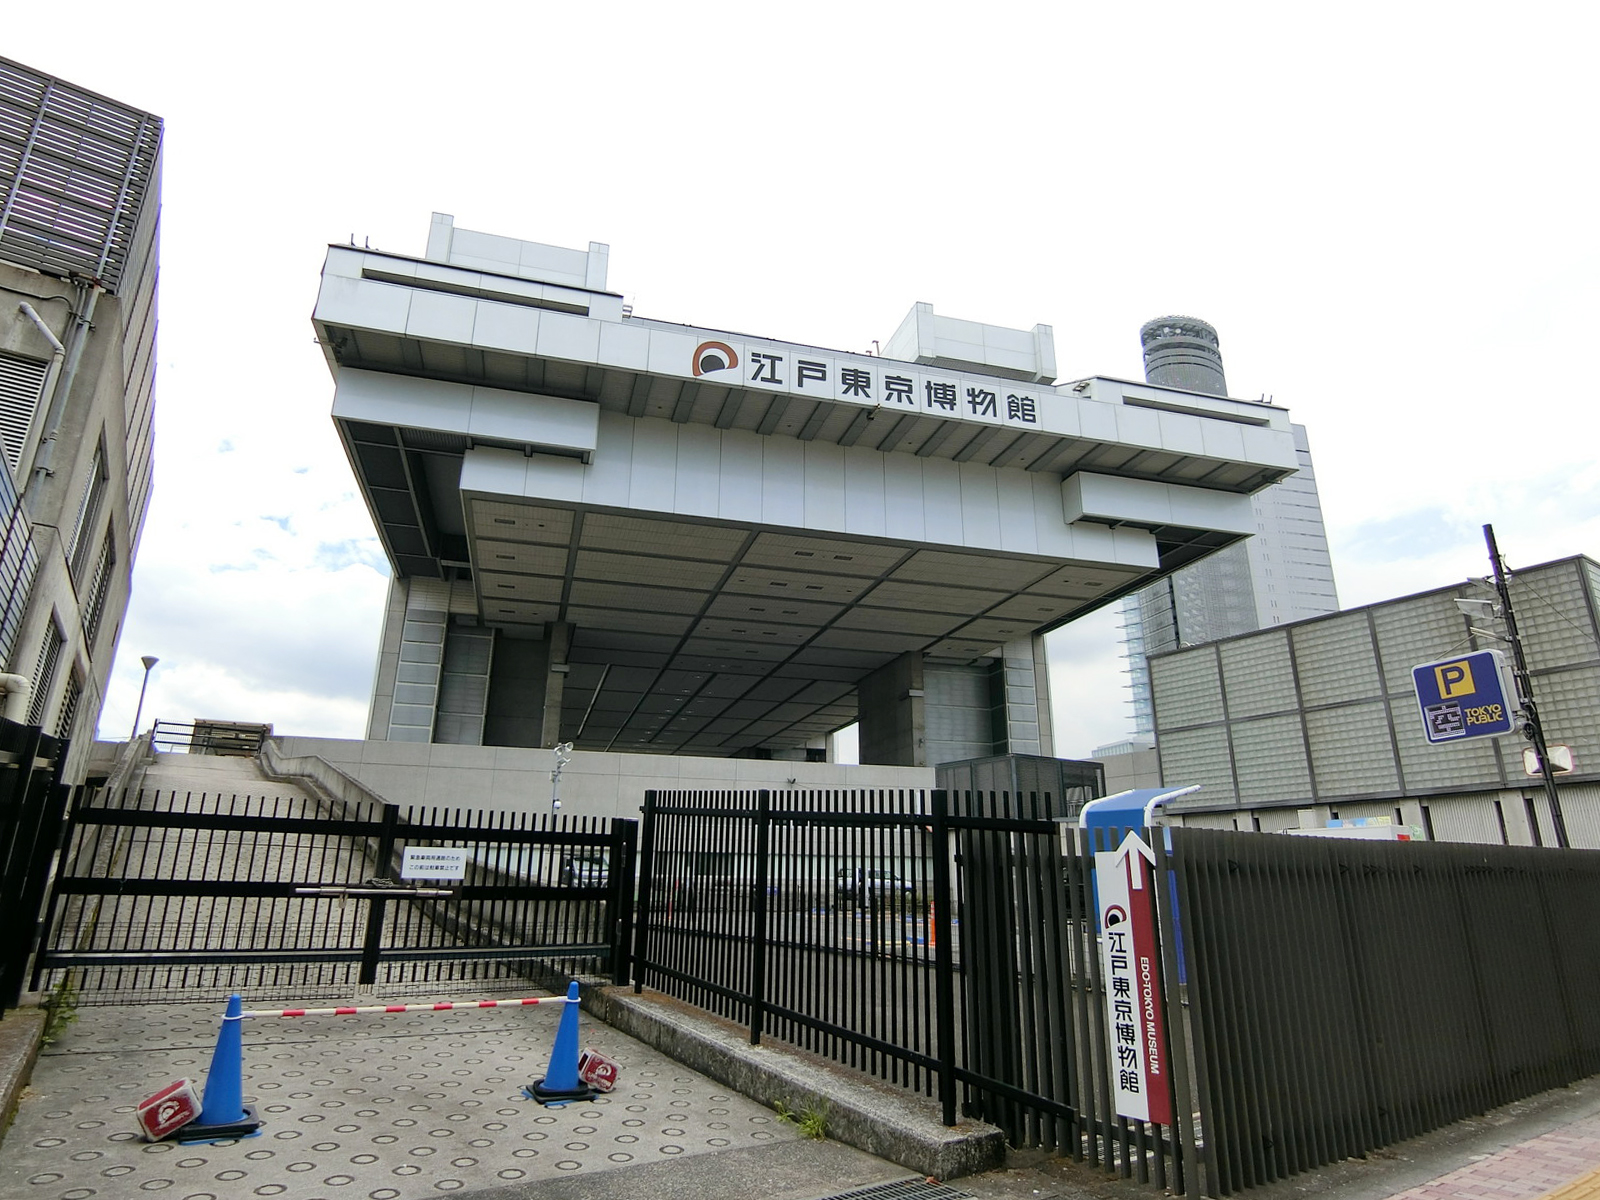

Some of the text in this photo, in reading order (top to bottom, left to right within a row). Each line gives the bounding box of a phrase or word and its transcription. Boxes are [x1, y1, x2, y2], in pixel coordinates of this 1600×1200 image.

[751, 351, 1037, 424] 江戸東京博物館
[1441, 665, 1465, 695] P
[1464, 704, 1502, 717] TOKYO
[1466, 712, 1504, 726] PUBLIC
[1108, 931, 1140, 1094] 江戸東京博物館
[1140, 956, 1160, 1075] EDO-TOKYO MUSEUM
